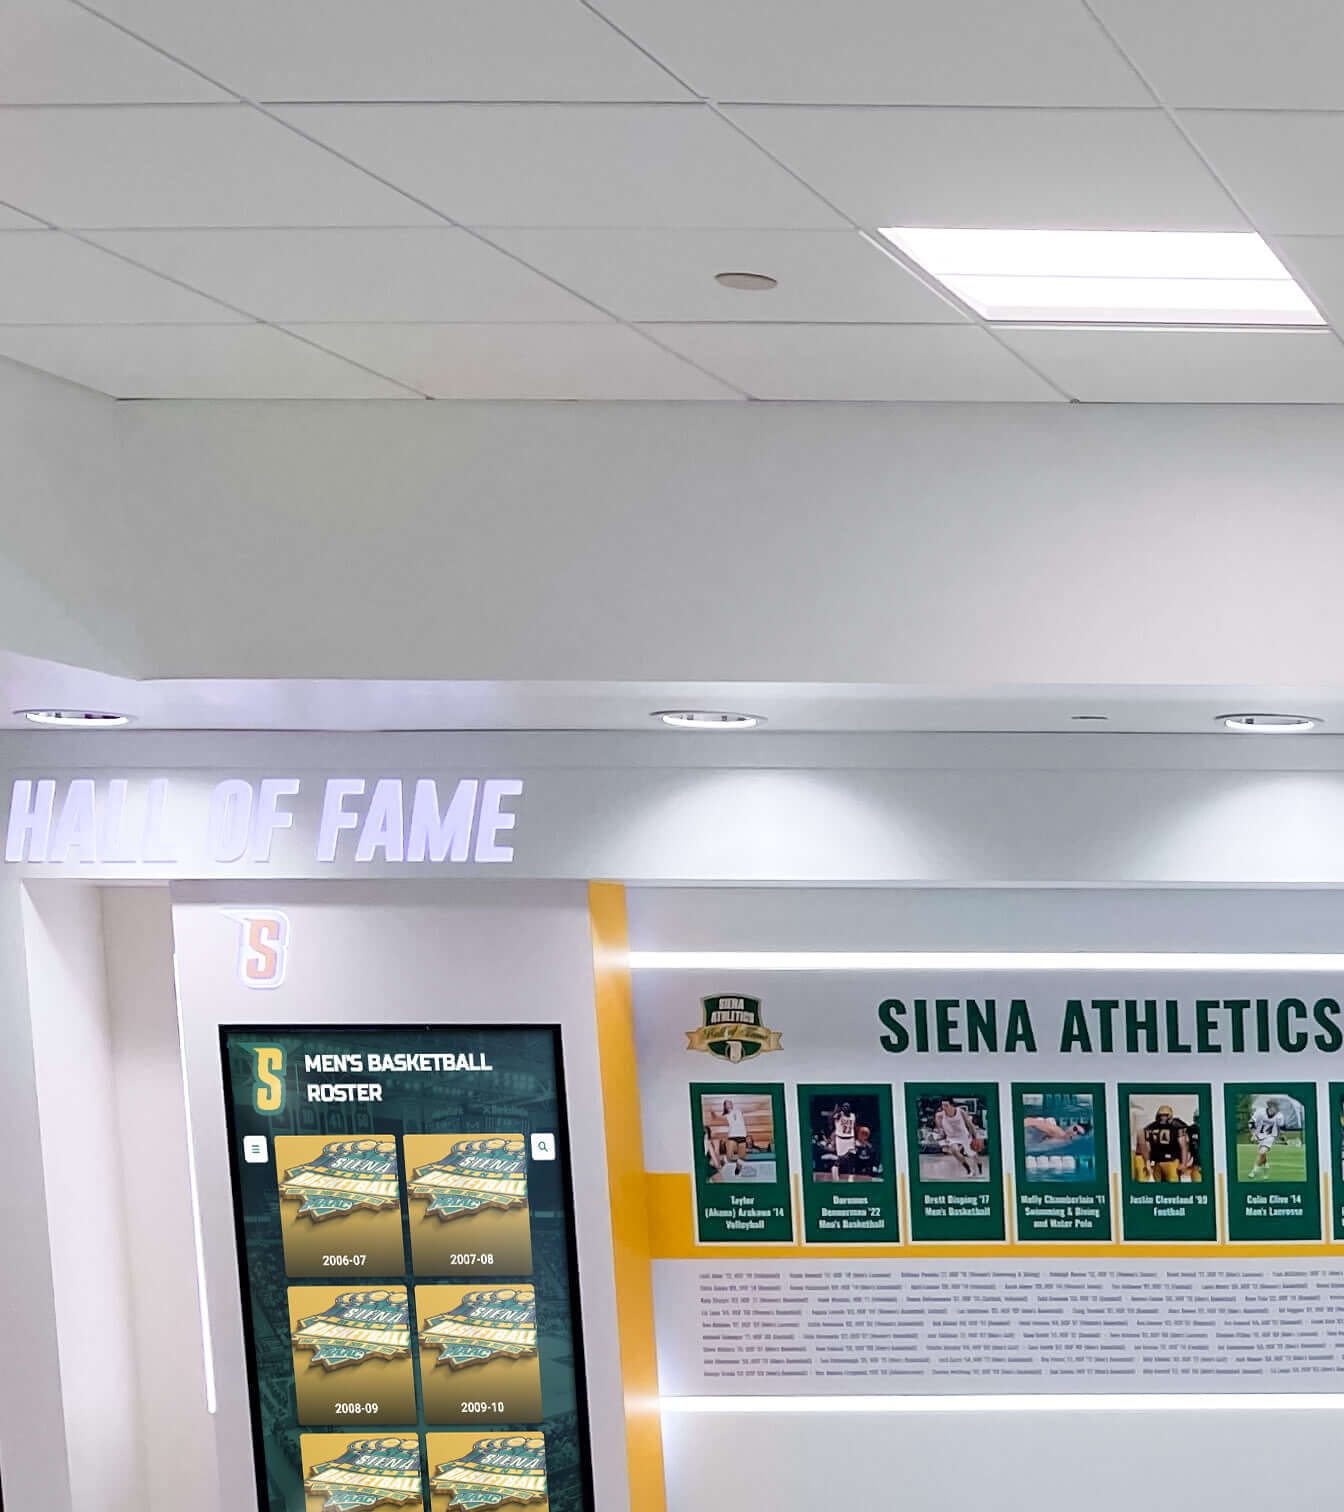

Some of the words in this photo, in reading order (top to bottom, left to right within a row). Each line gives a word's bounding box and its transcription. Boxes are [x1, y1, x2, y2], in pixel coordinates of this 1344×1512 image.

[4, 779, 179, 864] HALL
[207, 779, 300, 864] OF
[316, 779, 523, 863] FAME
[878, 998, 1037, 1053] SIENA
[1060, 998, 1343, 1053] ATHLETICS
[304, 1054, 363, 1073] MEN'S
[368, 1053, 493, 1072] BASKETBALL
[248, 1045, 285, 1113] S
[307, 1084, 382, 1102] ROSTER
[331, 1157, 390, 1174] SIENA
[458, 1156, 520, 1173] SIENA
[322, 1255, 367, 1266] 2006-07
[450, 1254, 494, 1265] 2007-08
[343, 1305, 403, 1323] SIENA
[471, 1305, 529, 1322] SIENA
[335, 1403, 379, 1414] 2008-09
[460, 1402, 504, 1413] 2009-10
[356, 1453, 417, 1470] SIENA
[481, 1453, 540, 1469] SIENA
